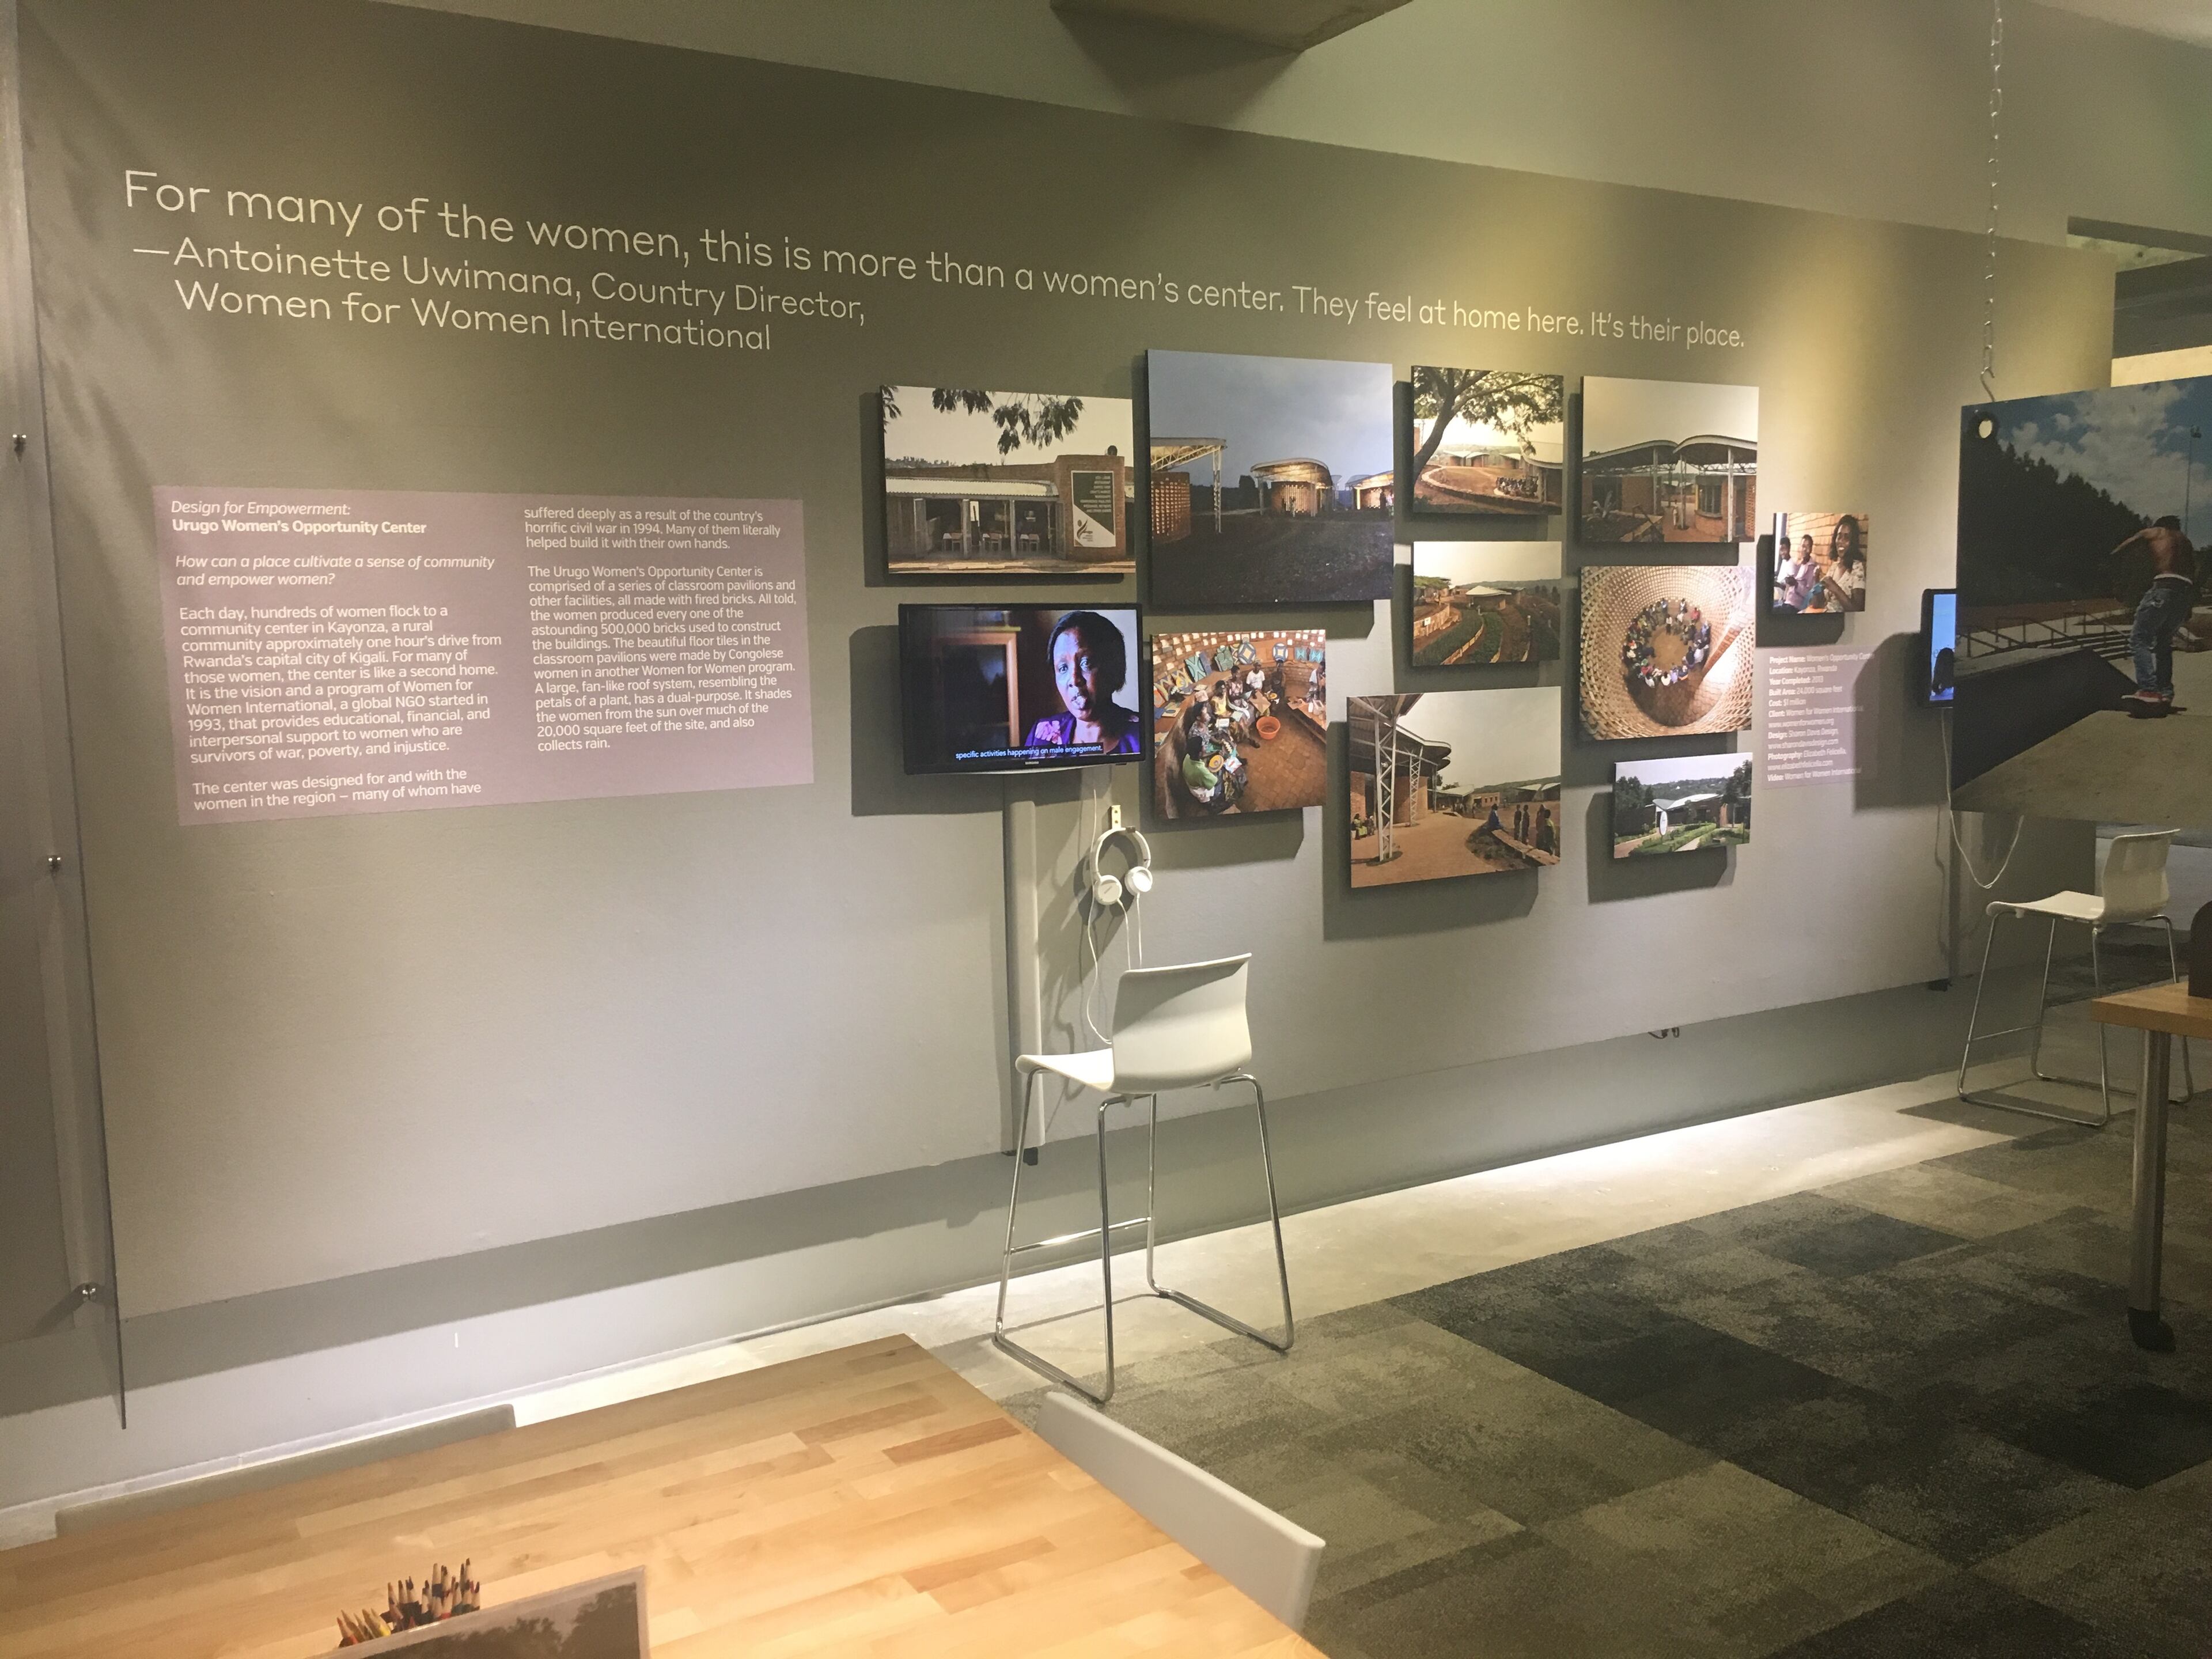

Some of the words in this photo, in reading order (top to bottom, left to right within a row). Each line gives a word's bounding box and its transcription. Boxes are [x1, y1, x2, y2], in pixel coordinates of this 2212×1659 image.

[124, 169, 211, 213] For
[227, 191, 363, 237] many
[377, 197, 430, 233] of
[437, 202, 514, 243] the
[526, 221, 689, 268] women,
[699, 228, 772, 267] this
[784, 236, 812, 271] is
[823, 250, 916, 280] more
[925, 251, 1005, 288] than
[1014, 268, 1033, 290] a
[1043, 271, 1179, 303] women's
[1187, 281, 1284, 312] center.
[1291, 285, 1359, 325] They
[1365, 291, 1411, 322] feel
[1419, 299, 1446, 325] at
[1453, 300, 1521, 331] home
[1528, 306, 1584, 335] here.
[1591, 311, 1624, 338] It's
[1629, 315, 1681, 342] their
[1687, 320, 1744, 350] place.
[403, 255, 581, 305] Uwimana,
[591, 272, 726, 316] Country
[735, 284, 865, 327] Director,
[174, 279, 331, 320] Women
[341, 291, 401, 324] for
[410, 297, 550, 335] Women
[561, 309, 770, 350] International
[171, 500, 220, 516] Design
[224, 501, 244, 516] for
[247, 501, 350, 517] Empowerment:
[172, 518, 218, 534] Urugo
[221, 519, 289, 532] Women's
[291, 520, 378, 536] Opportunity
[381, 521, 427, 533] Center
[525, 521, 567, 533] horrific
[570, 521, 592, 533] civil
[594, 524, 617, 533] war
[619, 522, 630, 533] in
[632, 522, 662, 534] 1994.
[665, 523, 696, 537] Many
[698, 523, 709, 535] of
[711, 524, 740, 535] them
[743, 524, 781, 537] literally
[175, 555, 208, 567] How
[210, 558, 237, 567] can
[240, 558, 249, 567] a
[252, 555, 290, 570] place
[293, 555, 351, 567] cultivate
[354, 558, 363, 567] a
[366, 558, 405, 567] sense
[407, 555, 422, 570] of
[423, 555, 495, 570] community
[176, 573, 205, 585] and
[207, 575, 275, 588] empower
[277, 573, 335, 585] women?
[528, 579, 590, 594] comprised
[593, 579, 605, 591] of
[608, 582, 615, 591] a
[618, 579, 652, 591] series
[654, 579, 666, 591] of
[668, 579, 724, 590] classroom
[726, 579, 774, 593] pavilions
[775, 579, 796, 590] and
[179, 607, 214, 619] Each
[218, 606, 247, 622] day,
[251, 605, 317, 619] hundreds
[320, 605, 334, 618] of
[336, 607, 386, 617] women
[388, 604, 421, 616] flock
[423, 605, 437, 616] to
[440, 607, 448, 616] a
[531, 623, 597, 637] astounding
[601, 622, 650, 635] 500,000
[653, 622, 686, 633] bricks
[688, 621, 715, 632] used
[717, 622, 729, 632] to
[730, 620, 781, 631] construct
[181, 638, 262, 653] community
[266, 635, 363, 653] approximately
[366, 638, 391, 647] one
[394, 635, 435, 647] hour's
[437, 634, 469, 646] drive
[471, 634, 501, 645] from
[184, 671, 225, 684] those
[228, 671, 284, 682] women,
[287, 668, 310, 681] the
[313, 668, 357, 680] center
[359, 666, 370, 679] is
[373, 666, 396, 678] like
[398, 668, 407, 677] a
[410, 664, 456, 677] second
[459, 664, 498, 675] home.
[186, 703, 242, 715] Women
[245, 698, 336, 713] International,
[340, 700, 348, 710] a
[351, 696, 392, 712] global
[395, 695, 425, 707] NGO
[428, 693, 474, 706] started
[476, 692, 488, 704] in
[537, 724, 580, 737] 20,000
[583, 724, 622, 737] square
[625, 721, 648, 733] feet
[650, 720, 661, 732] of
[663, 719, 682, 731] the
[684, 718, 707, 730] site,
[709, 717, 730, 729] and
[732, 716, 755, 728] also
[956, 749, 979, 760] specific
[980, 749, 1006, 757] activities
[1007, 747, 1039, 759] happening
